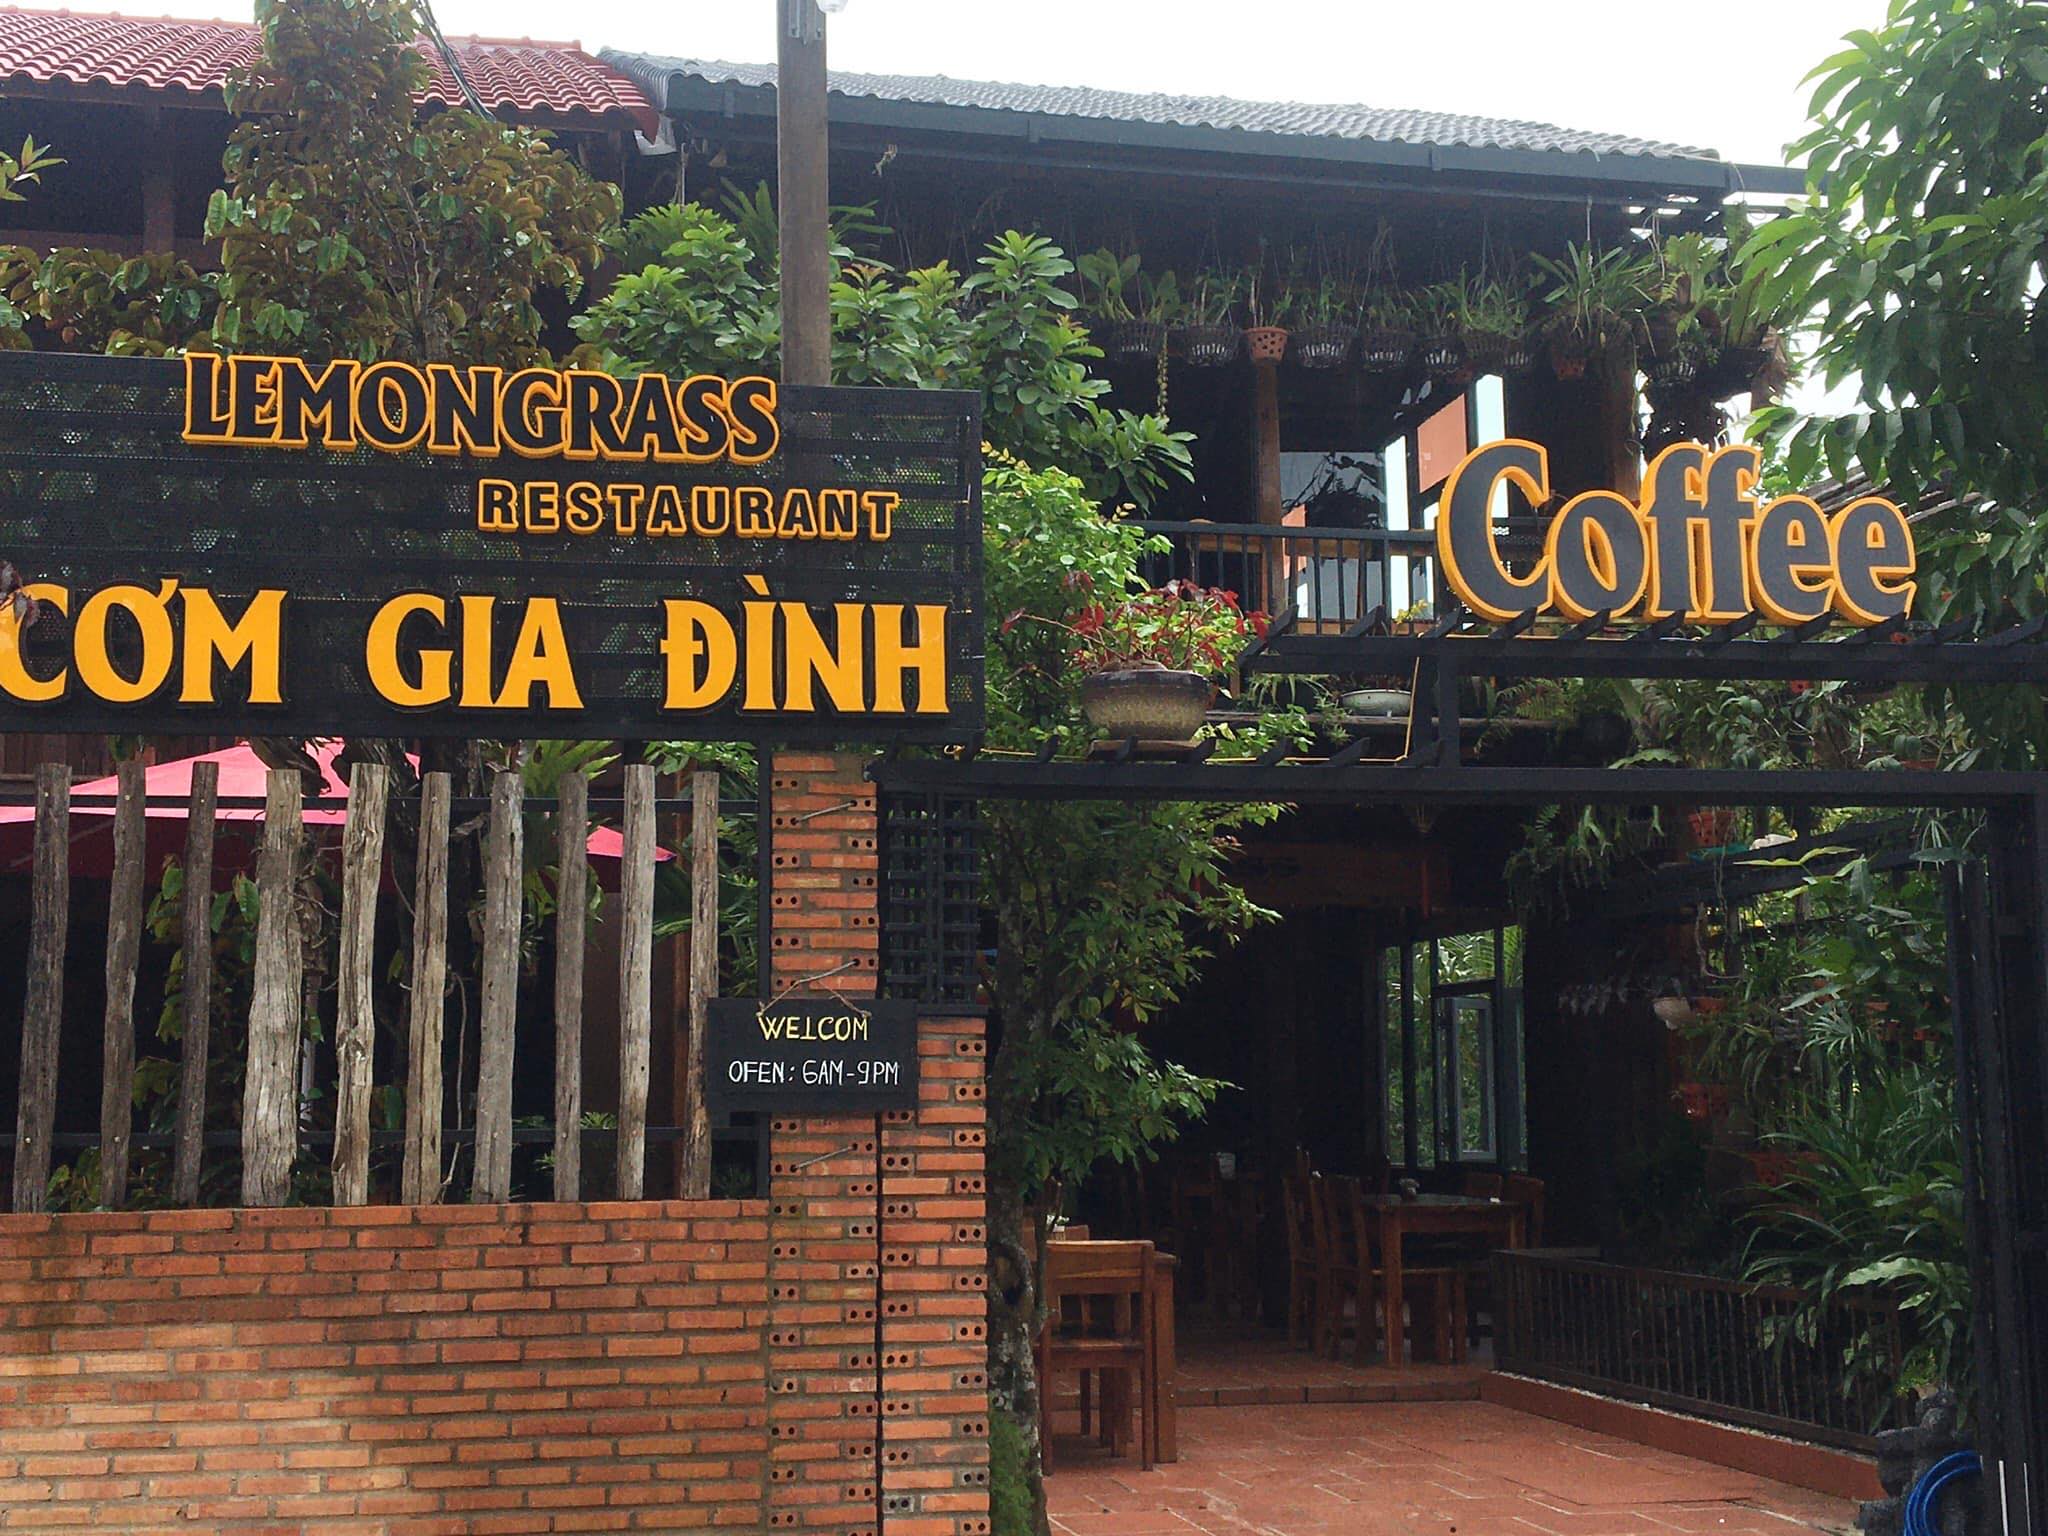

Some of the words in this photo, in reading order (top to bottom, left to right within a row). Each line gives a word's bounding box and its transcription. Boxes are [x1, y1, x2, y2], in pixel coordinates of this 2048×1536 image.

[181, 351, 781, 466] LEMONGRASS
[477, 478, 903, 543] RESTAURANT
[1437, 438, 1918, 628] Coffee
[0, 578, 288, 704] CƠM
[365, 592, 585, 710] GIA
[660, 574, 952, 715] ĐÌNH
[758, 1016, 869, 1041] WELCOM
